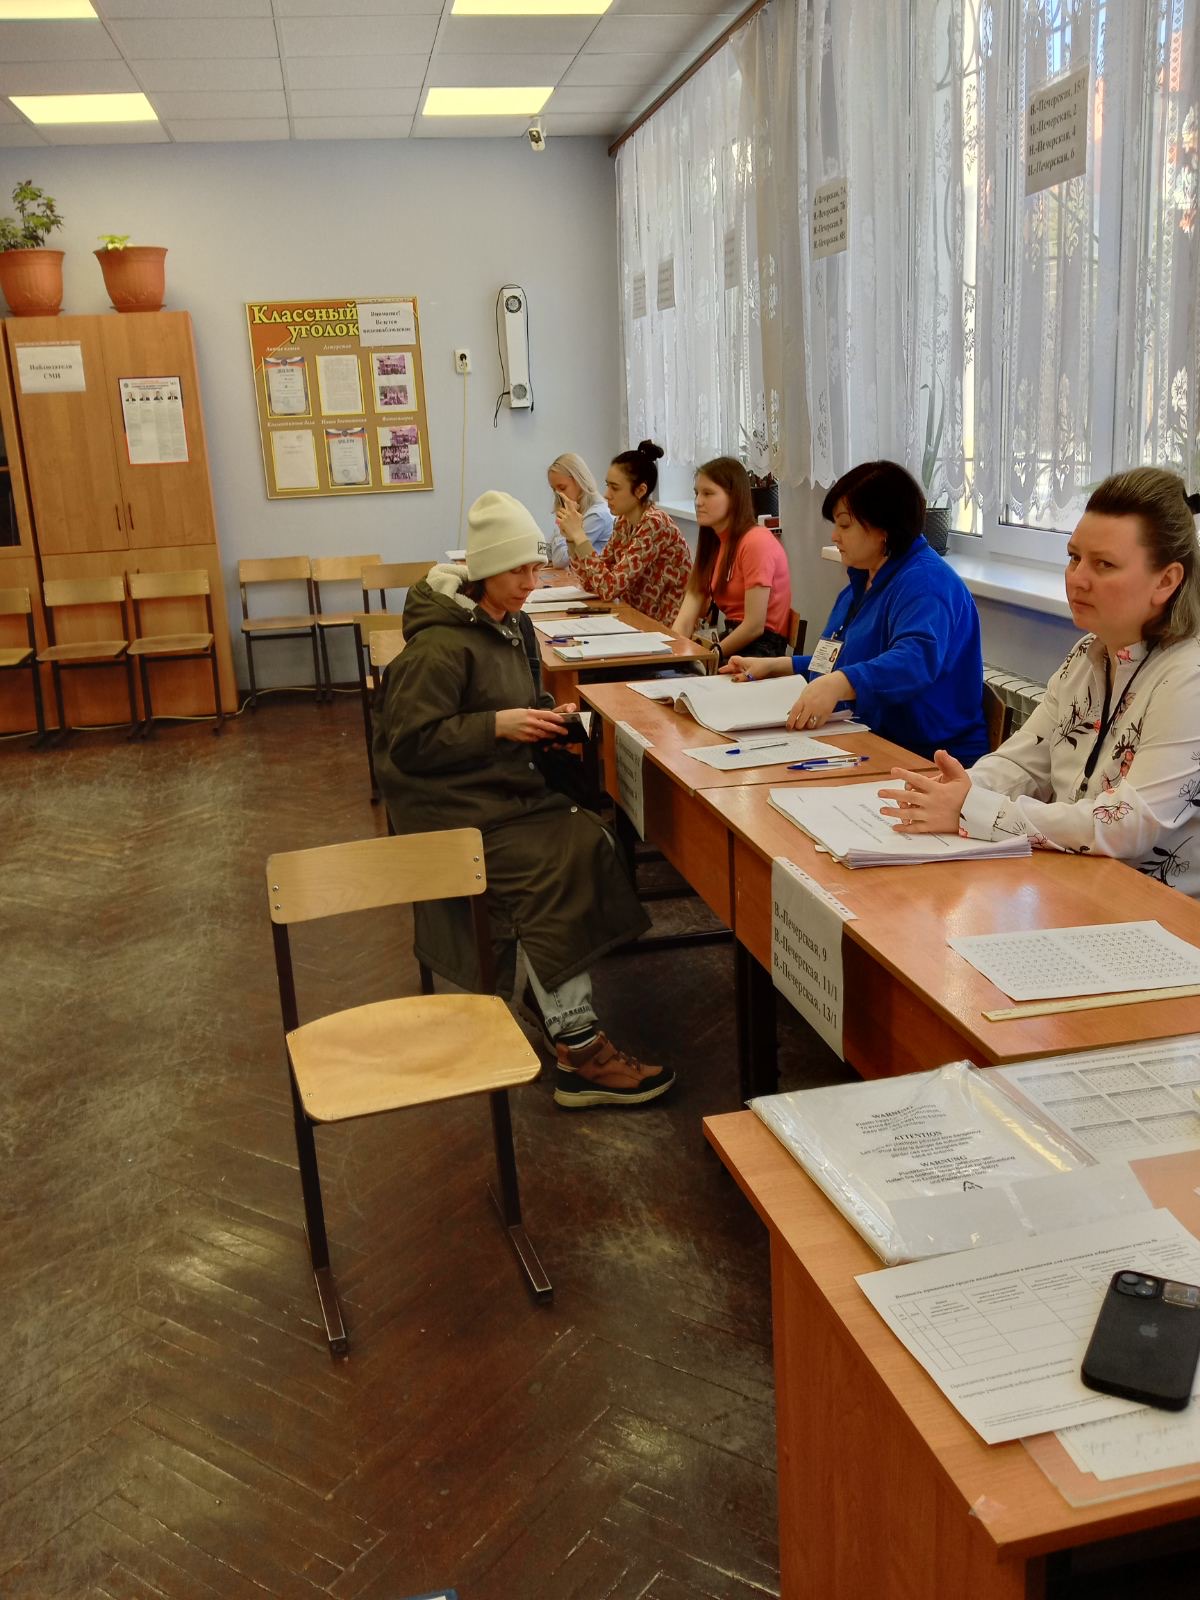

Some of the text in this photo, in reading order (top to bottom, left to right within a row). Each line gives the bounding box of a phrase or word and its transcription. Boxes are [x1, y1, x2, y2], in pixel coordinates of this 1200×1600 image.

[252, 300, 359, 324] Классный
[287, 320, 360, 344] уголок
[774, 901, 827, 962] В.-Печерская, 9
[774, 928, 838, 1002] В.-Печерская, 11/1
[773, 952, 838, 1030] В.-Печерская, 13/1
[894, 1131, 942, 1141] ATTENTION
[920, 1155, 968, 1167] WARNUNG
